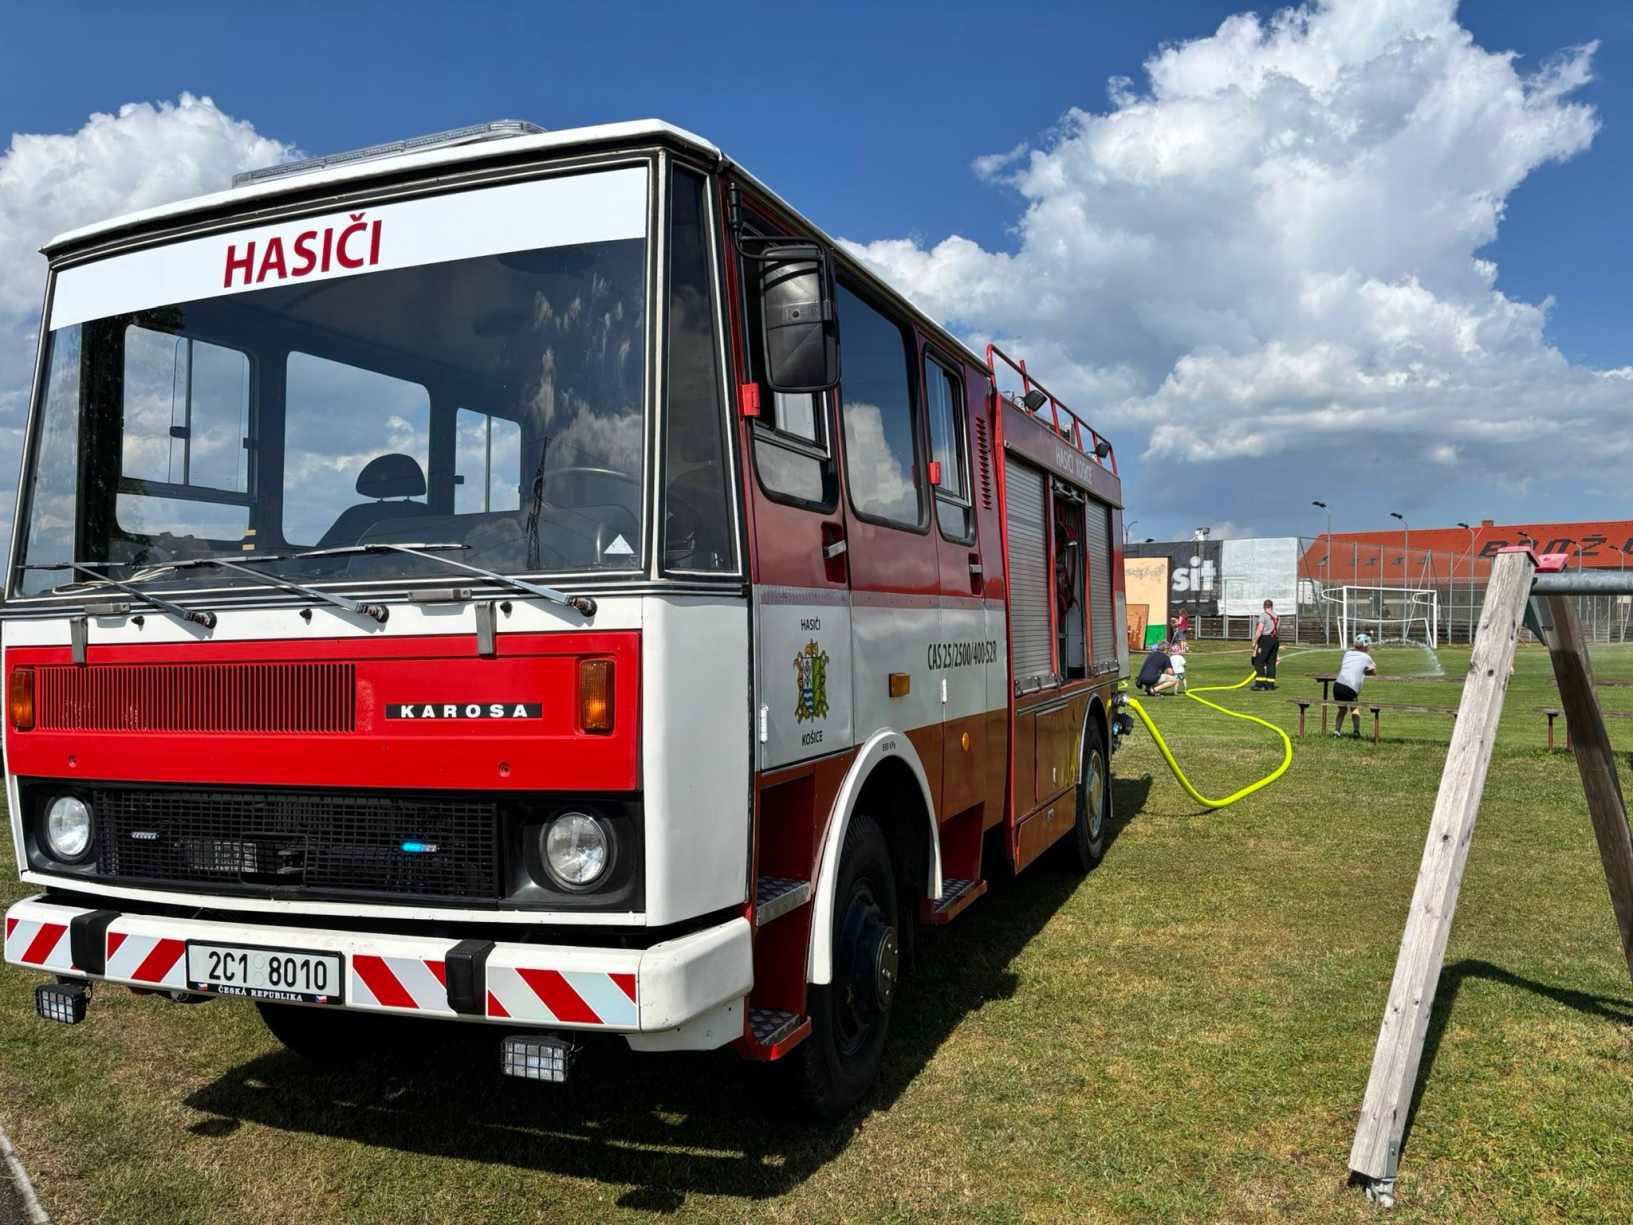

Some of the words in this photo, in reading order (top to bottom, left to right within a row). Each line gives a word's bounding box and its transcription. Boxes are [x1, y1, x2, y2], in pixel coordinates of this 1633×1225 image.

[224, 212, 382, 288] HASIČI
[1171, 555, 1217, 591] sit
[801, 616, 821, 631] HASIČI
[928, 643, 942, 670] CAS
[401, 704, 528, 718] KAROSA
[802, 729, 823, 746] KOŠICE
[208, 951, 248, 983] 2C1
[268, 956, 327, 990] 8010
[218, 986, 247, 996] ČESKÁ
[251, 989, 303, 1001] REPUBLIKA
